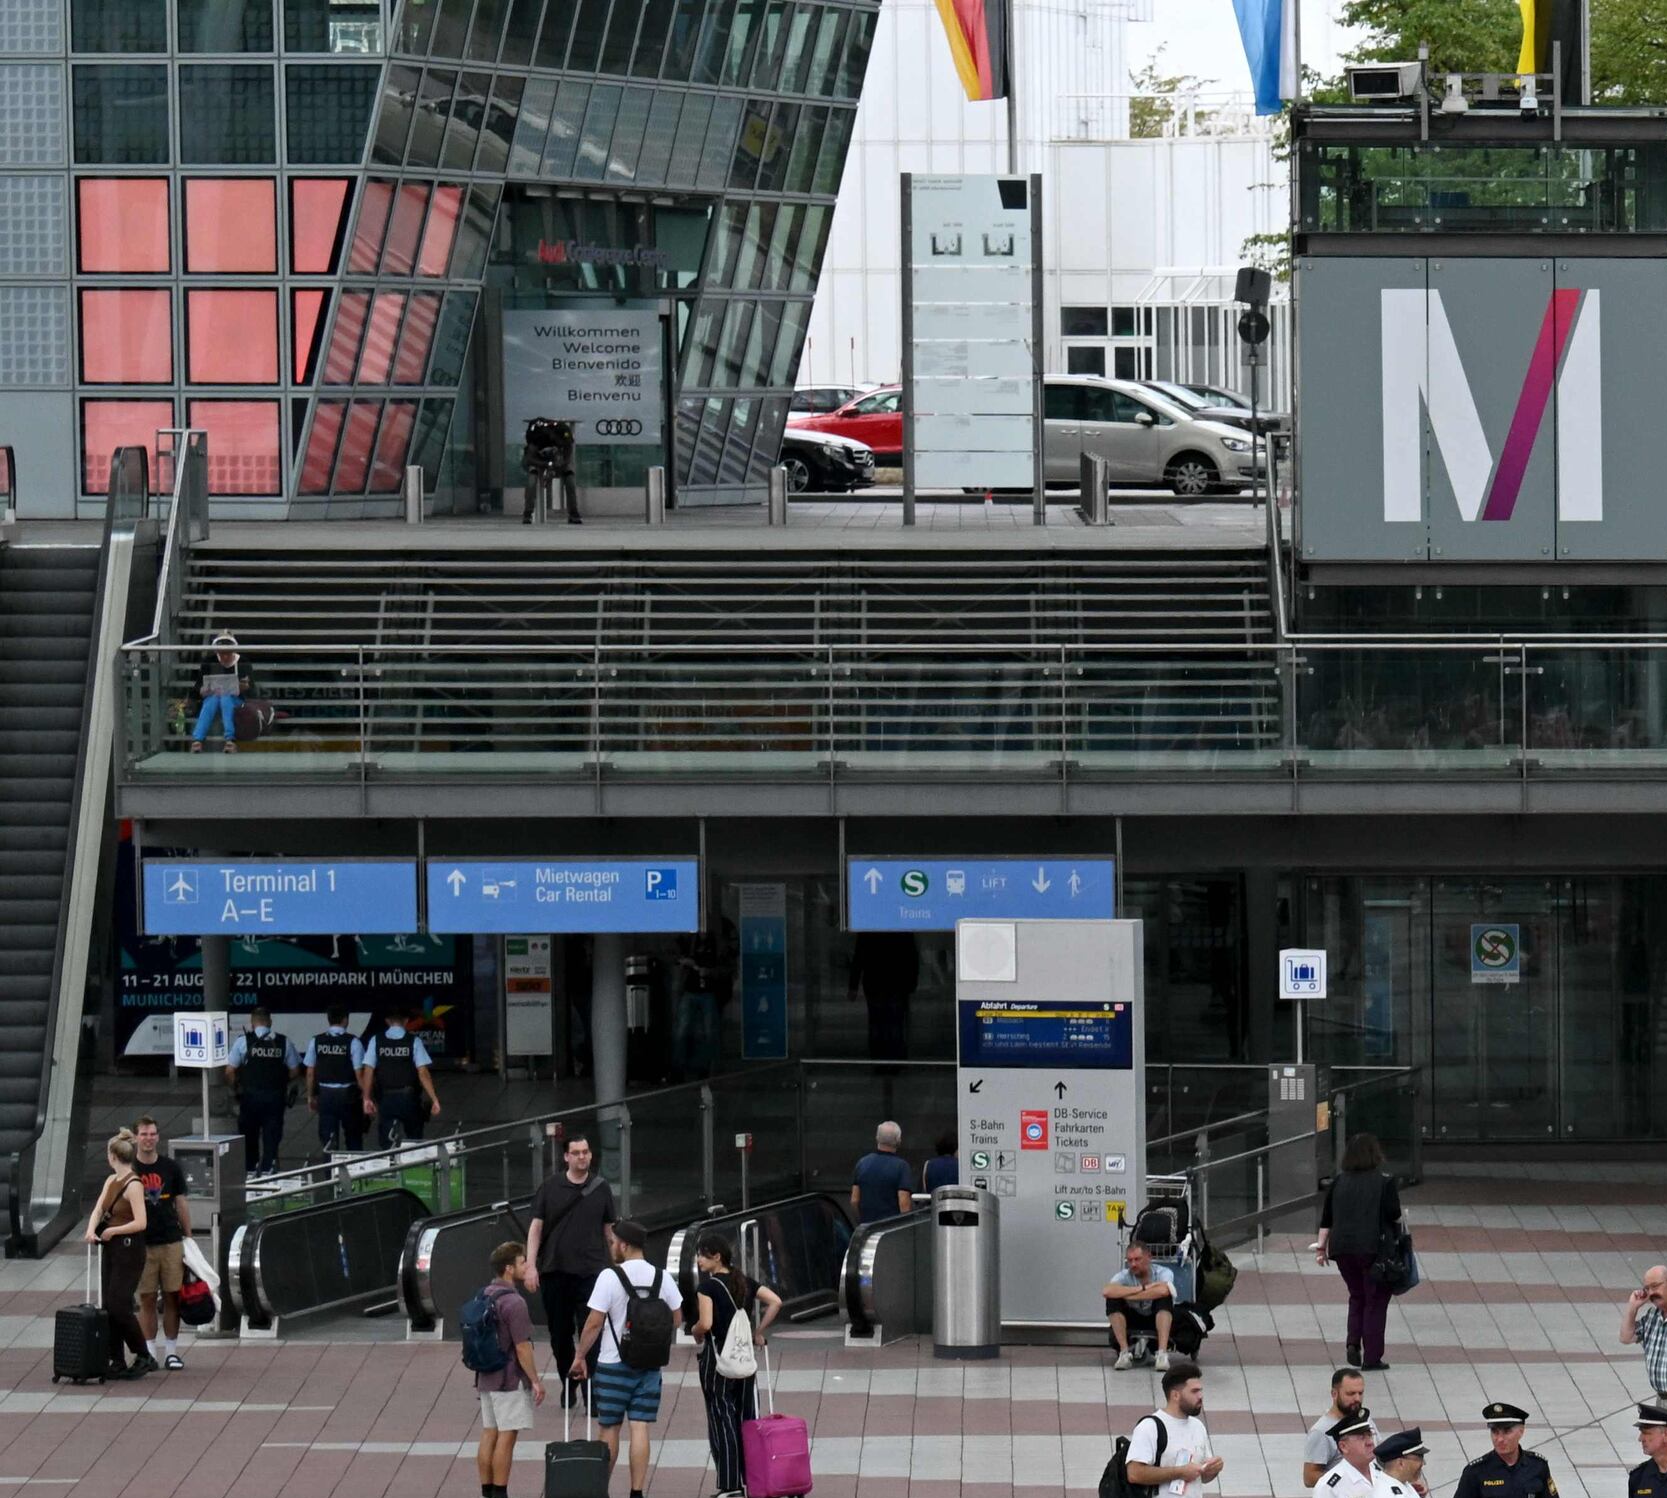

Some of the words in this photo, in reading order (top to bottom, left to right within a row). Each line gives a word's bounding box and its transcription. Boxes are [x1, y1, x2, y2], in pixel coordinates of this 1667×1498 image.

[534, 326, 640, 337] Willkommen
[563, 342, 641, 354] Welcome
[552, 359, 641, 370] Bienvenido
[567, 390, 641, 401] Bienvenu
[1381, 288, 1603, 522] M
[219, 869, 317, 892] Terminal
[327, 869, 337, 892] 1
[536, 868, 619, 889] Mietwagen
[647, 871, 662, 892] P
[982, 877, 1007, 889] LIFT
[536, 887, 561, 902] Car
[565, 887, 612, 902] Rental
[900, 906, 931, 919] Trains
[122, 974, 137, 987] 11
[153, 974, 170, 986] 21
[236, 973, 254, 986] 22
[264, 971, 368, 985] OLYMPIAPARK
[378, 967, 454, 985] MÜNCHEN
[980, 1002, 1008, 1010] Abfahrt
[379, 1047, 410, 1057] POLIZEI
[1054, 1108, 1108, 1120] DB-Service
[970, 1120, 1005, 1131] S-Bahn
[1054, 1122, 1105, 1134] Fahrkarten
[970, 1133, 999, 1145] Trains
[1055, 1137, 1089, 1148] Tickets
[1083, 1157, 1098, 1168] DB
[1054, 1185, 1068, 1195] Lift
[1069, 1185, 1094, 1196] zur/to
[1095, 1186, 1126, 1196] S-Bahn
[1083, 1206, 1099, 1215] LIFT
